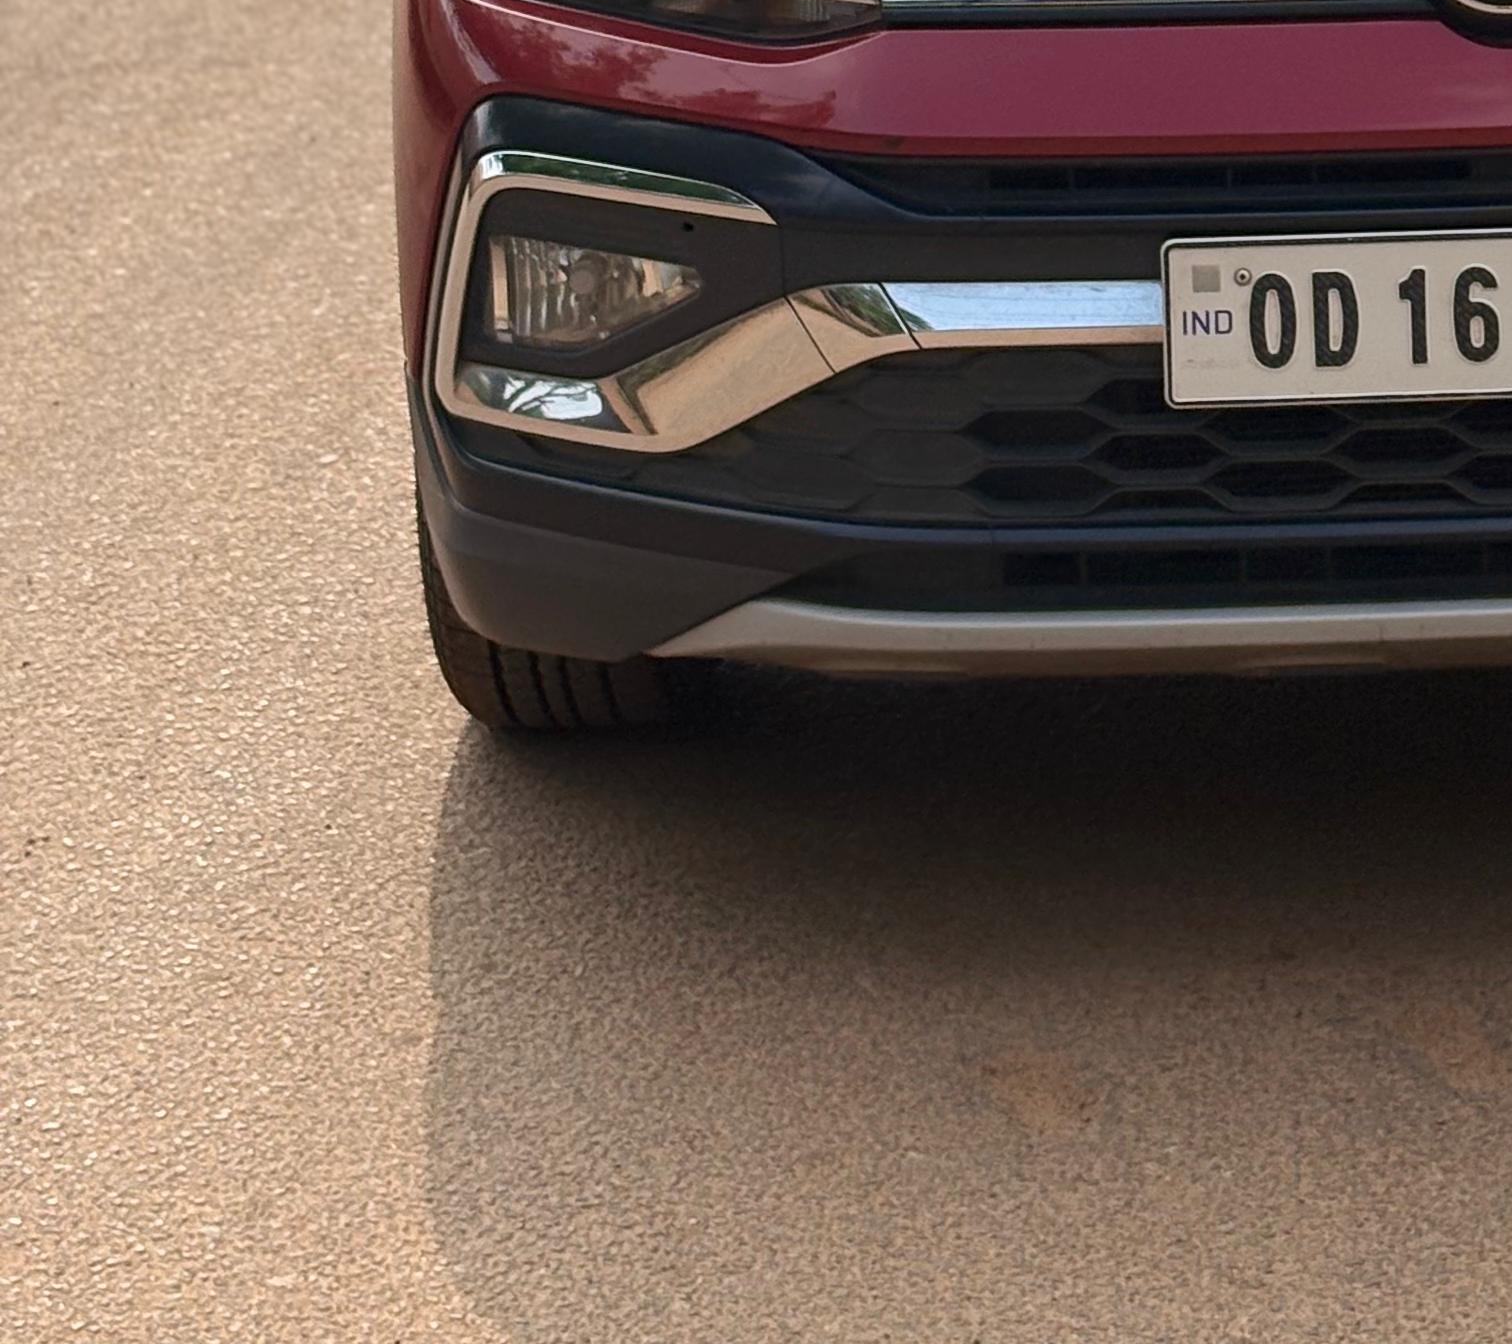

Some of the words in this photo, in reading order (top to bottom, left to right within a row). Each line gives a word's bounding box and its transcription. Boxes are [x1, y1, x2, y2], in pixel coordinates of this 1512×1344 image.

[1182, 309, 1234, 336] IND
[1248, 271, 1360, 370] OD
[1398, 265, 1500, 366] 16
